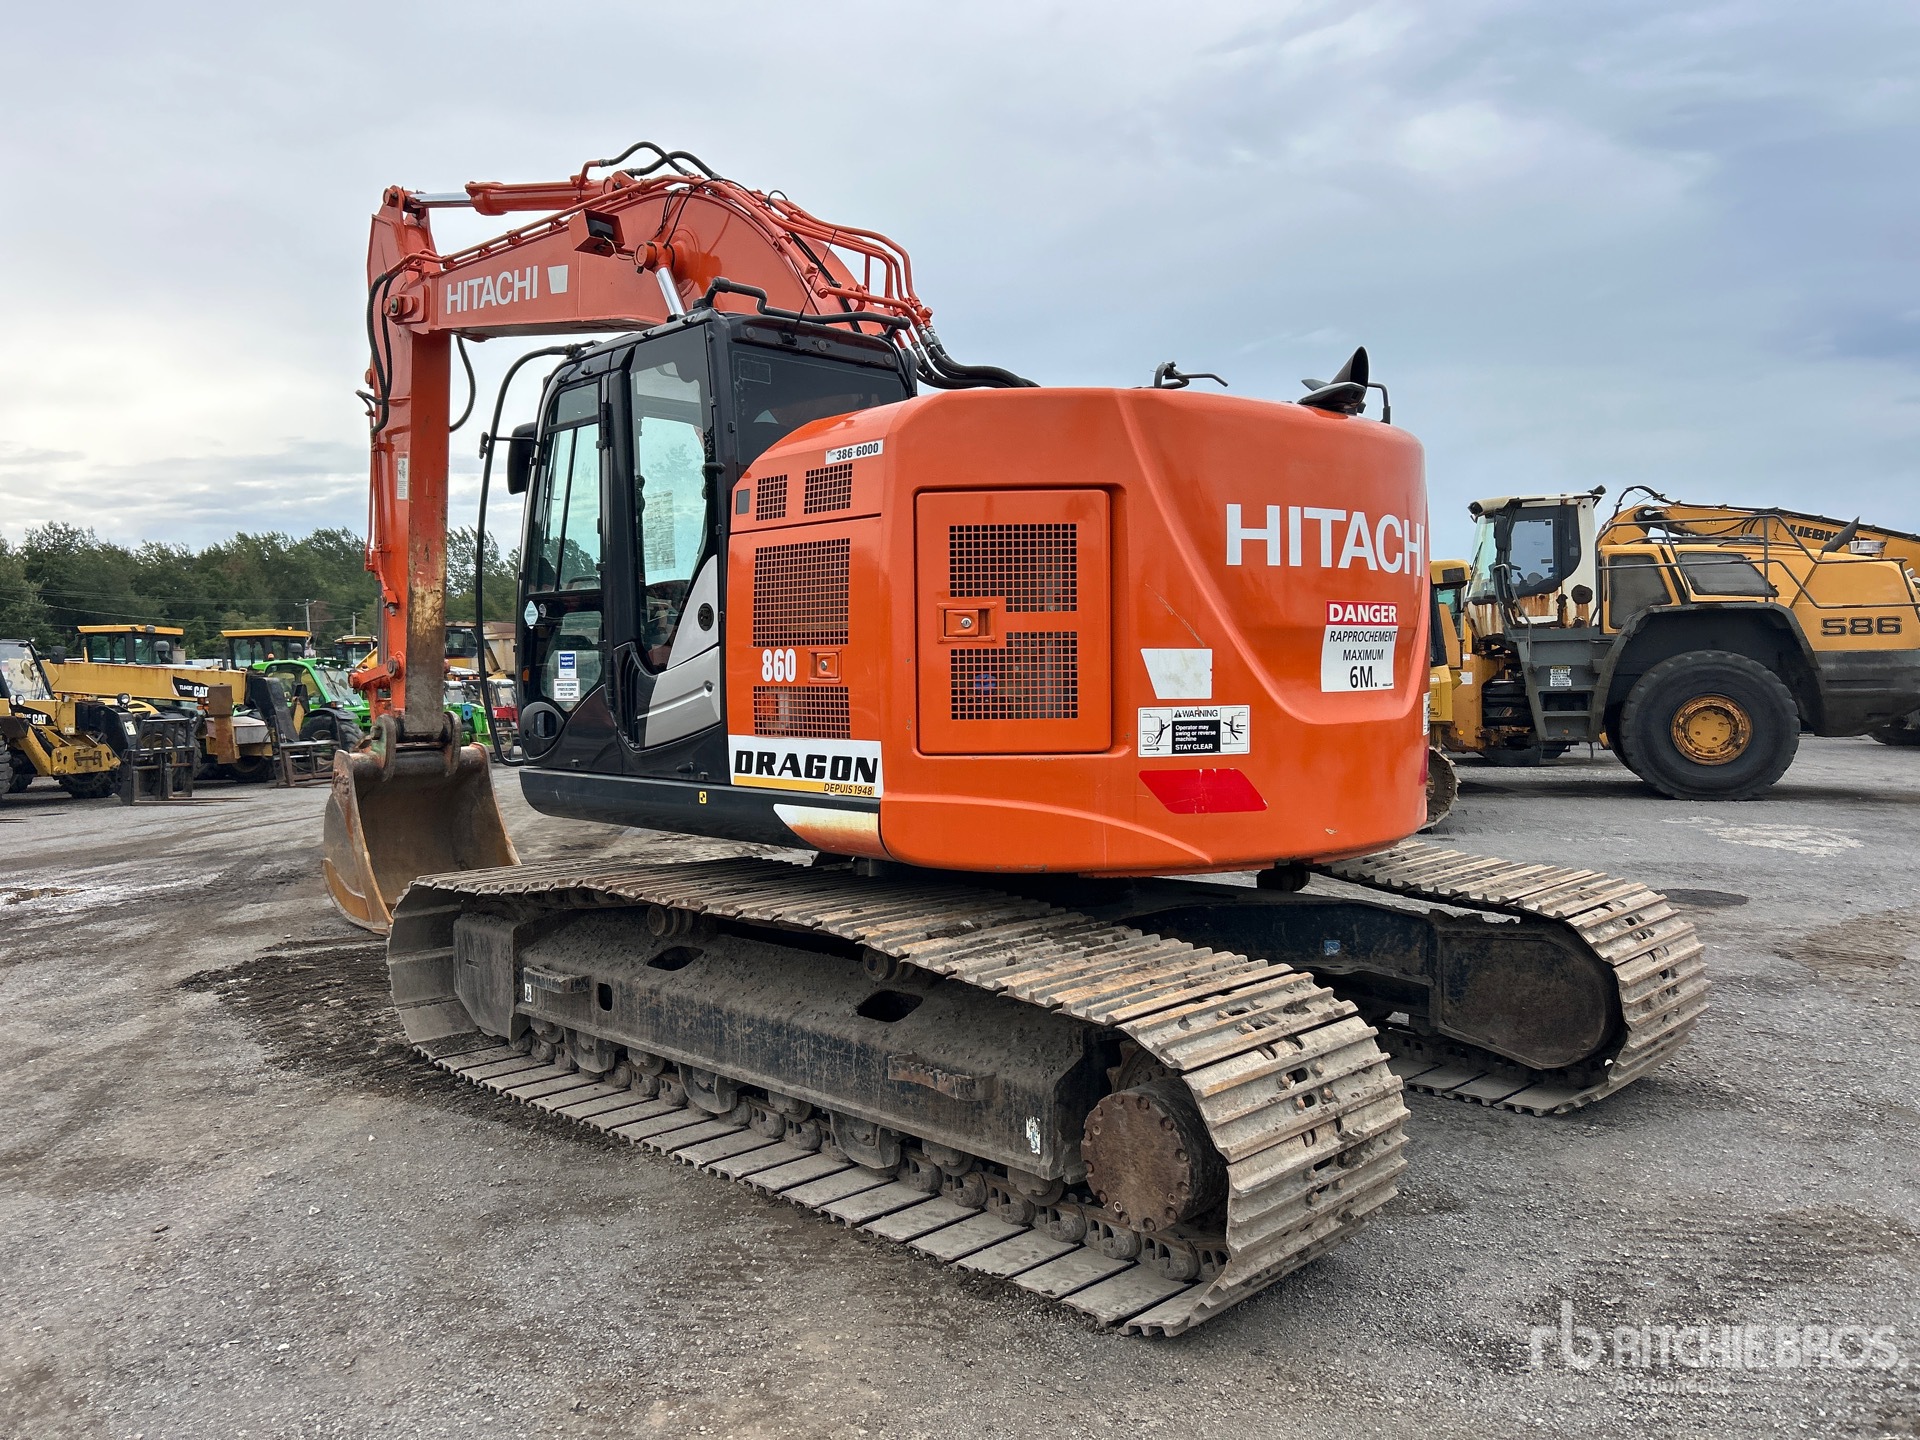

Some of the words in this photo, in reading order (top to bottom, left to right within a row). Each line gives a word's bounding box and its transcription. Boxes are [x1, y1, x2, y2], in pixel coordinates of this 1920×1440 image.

[446, 265, 538, 314] HITACHI
[836, 442, 879, 461] 386-6000
[1226, 503, 1425, 578] HITACHI
[1789, 524, 1872, 548] LIEBH
[1328, 603, 1397, 623] DANGER
[1329, 630, 1398, 643] RAPPROCHEMENT
[1821, 616, 1903, 637] 586
[1342, 648, 1384, 661] MAXIMUM
[761, 648, 797, 683] 860
[1349, 665, 1378, 689] 6M.
[193, 685, 210, 698] CAT
[32, 713, 48, 725] CAT
[1181, 709, 1218, 718] WARNING
[734, 750, 879, 783] DRAGON
[823, 783, 853, 795] DEPUIS
[853, 785, 873, 796] 1948
